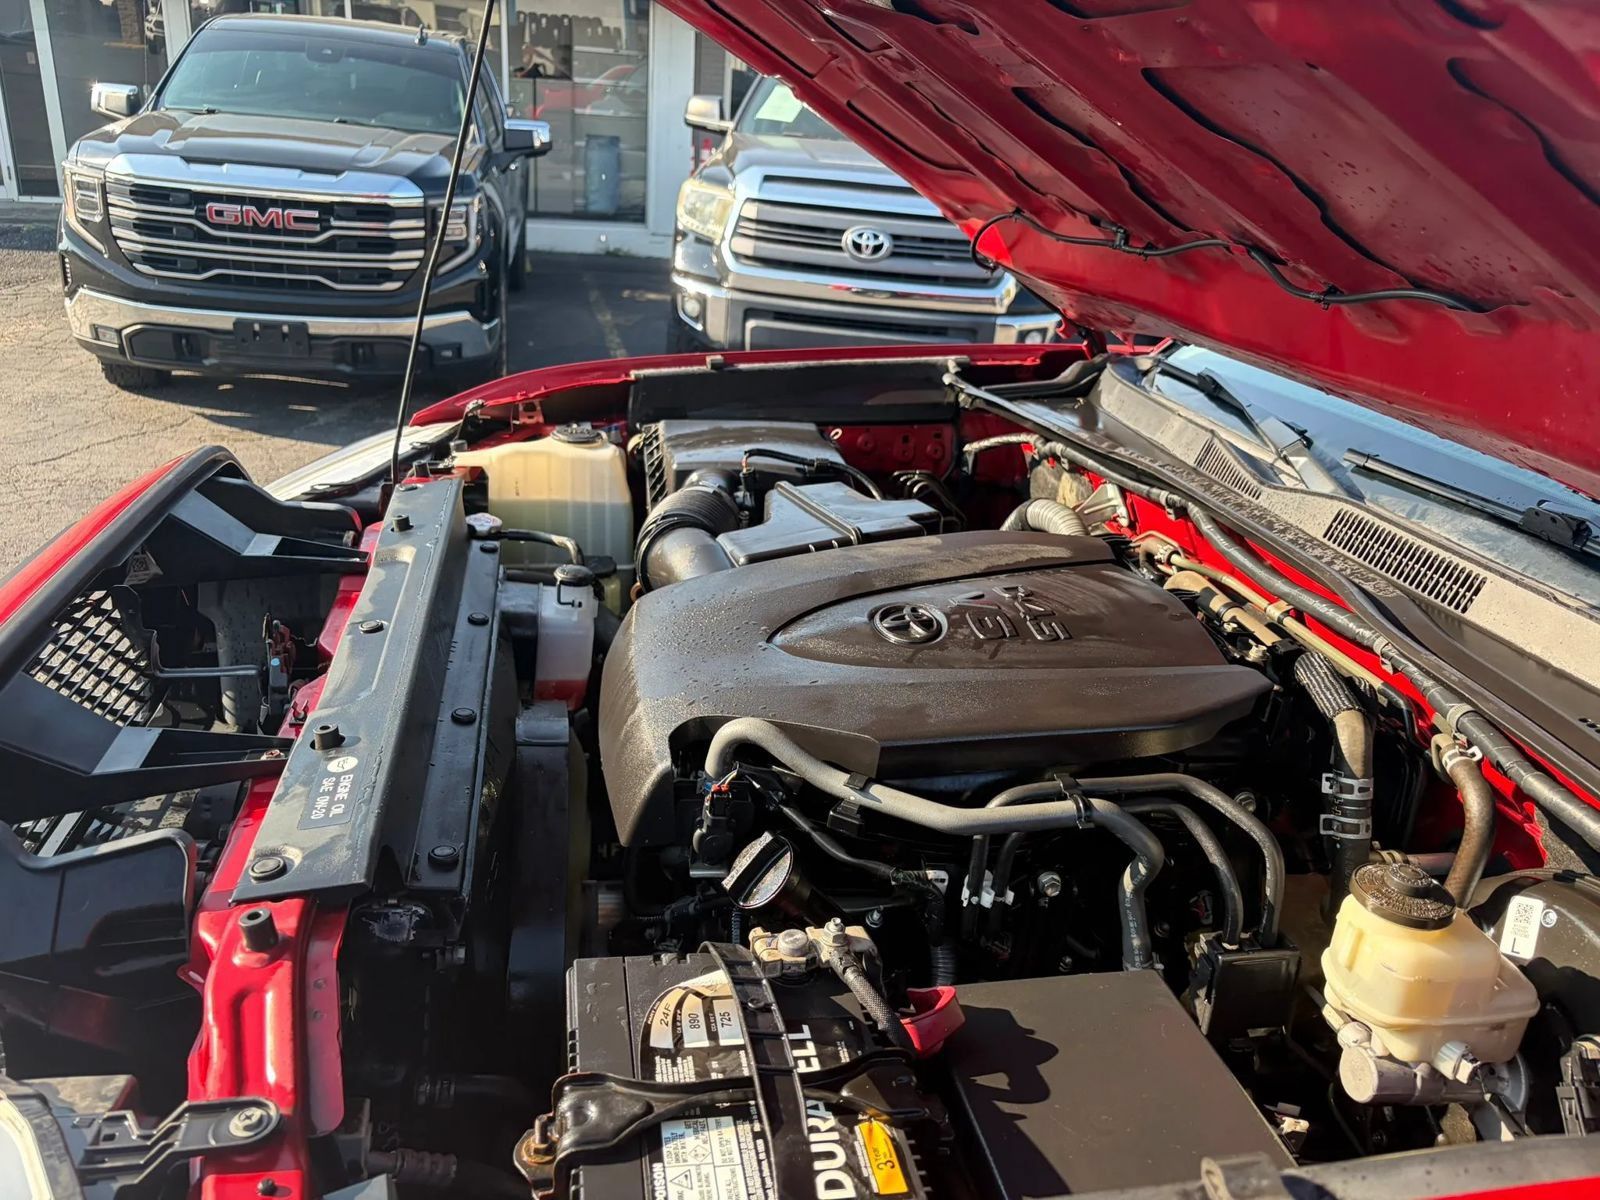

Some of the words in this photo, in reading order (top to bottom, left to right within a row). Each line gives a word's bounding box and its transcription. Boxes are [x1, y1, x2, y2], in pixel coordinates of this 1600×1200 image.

[206, 202, 320, 231] GMC
[319, 776, 336, 793] SAE
[335, 774, 353, 801] ENGINE
[311, 796, 329, 819] 0W-20
[329, 803, 345, 818] OIL
[660, 1003, 672, 1027] 24F
[688, 1013, 700, 1030] 890
[719, 1011, 733, 1028] 725
[788, 1024, 857, 1200] DURAELL
[876, 1160, 895, 1170] 3
